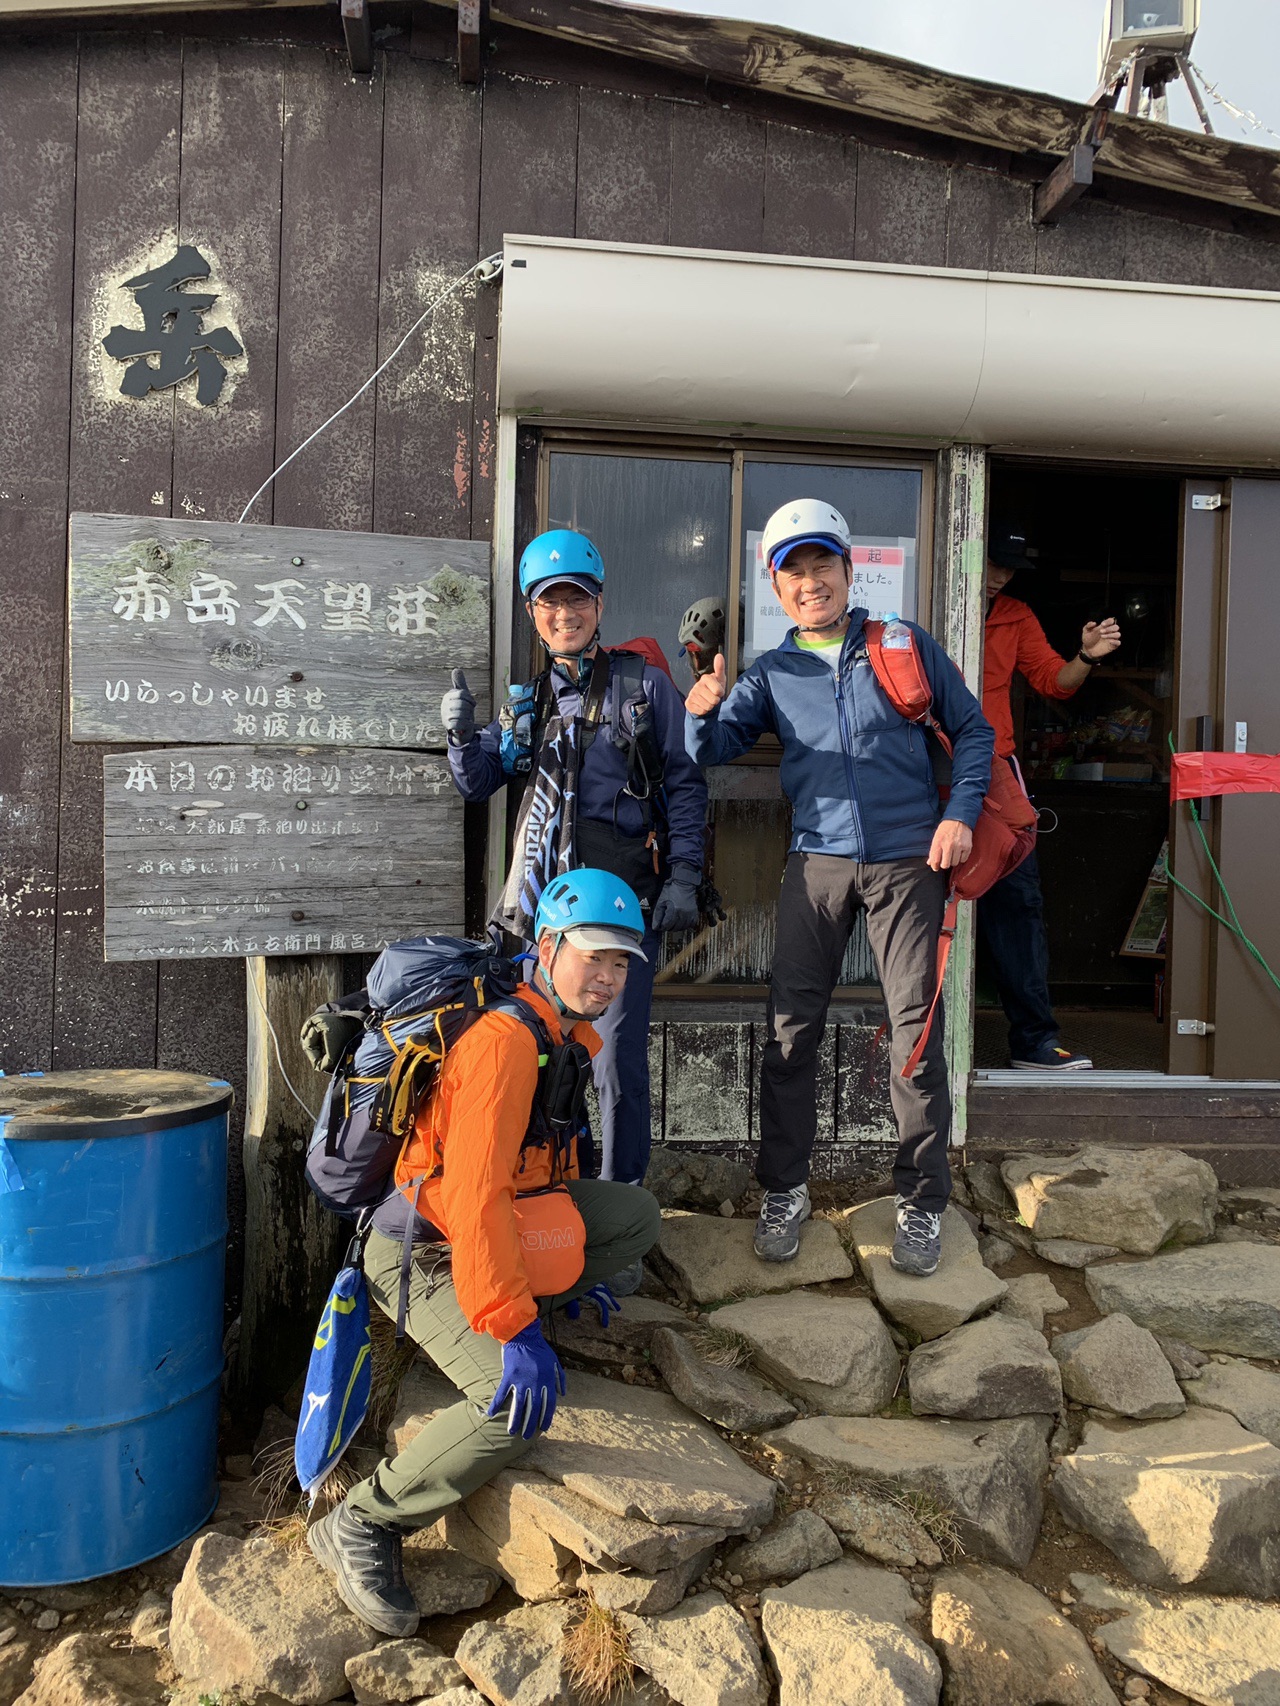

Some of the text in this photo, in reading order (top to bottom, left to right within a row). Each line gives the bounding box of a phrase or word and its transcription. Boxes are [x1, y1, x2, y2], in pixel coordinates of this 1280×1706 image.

[101, 245, 243, 406] 岳
[867, 548, 882, 563] 起
[854, 572, 893, 585] ました。
[112, 566, 440, 636] 赤岳天望荘
[105, 678, 326, 711] いらっしゃいませ
[231, 711, 441, 743] お疲れ様でした
[521, 1226, 575, 1251] OMM
